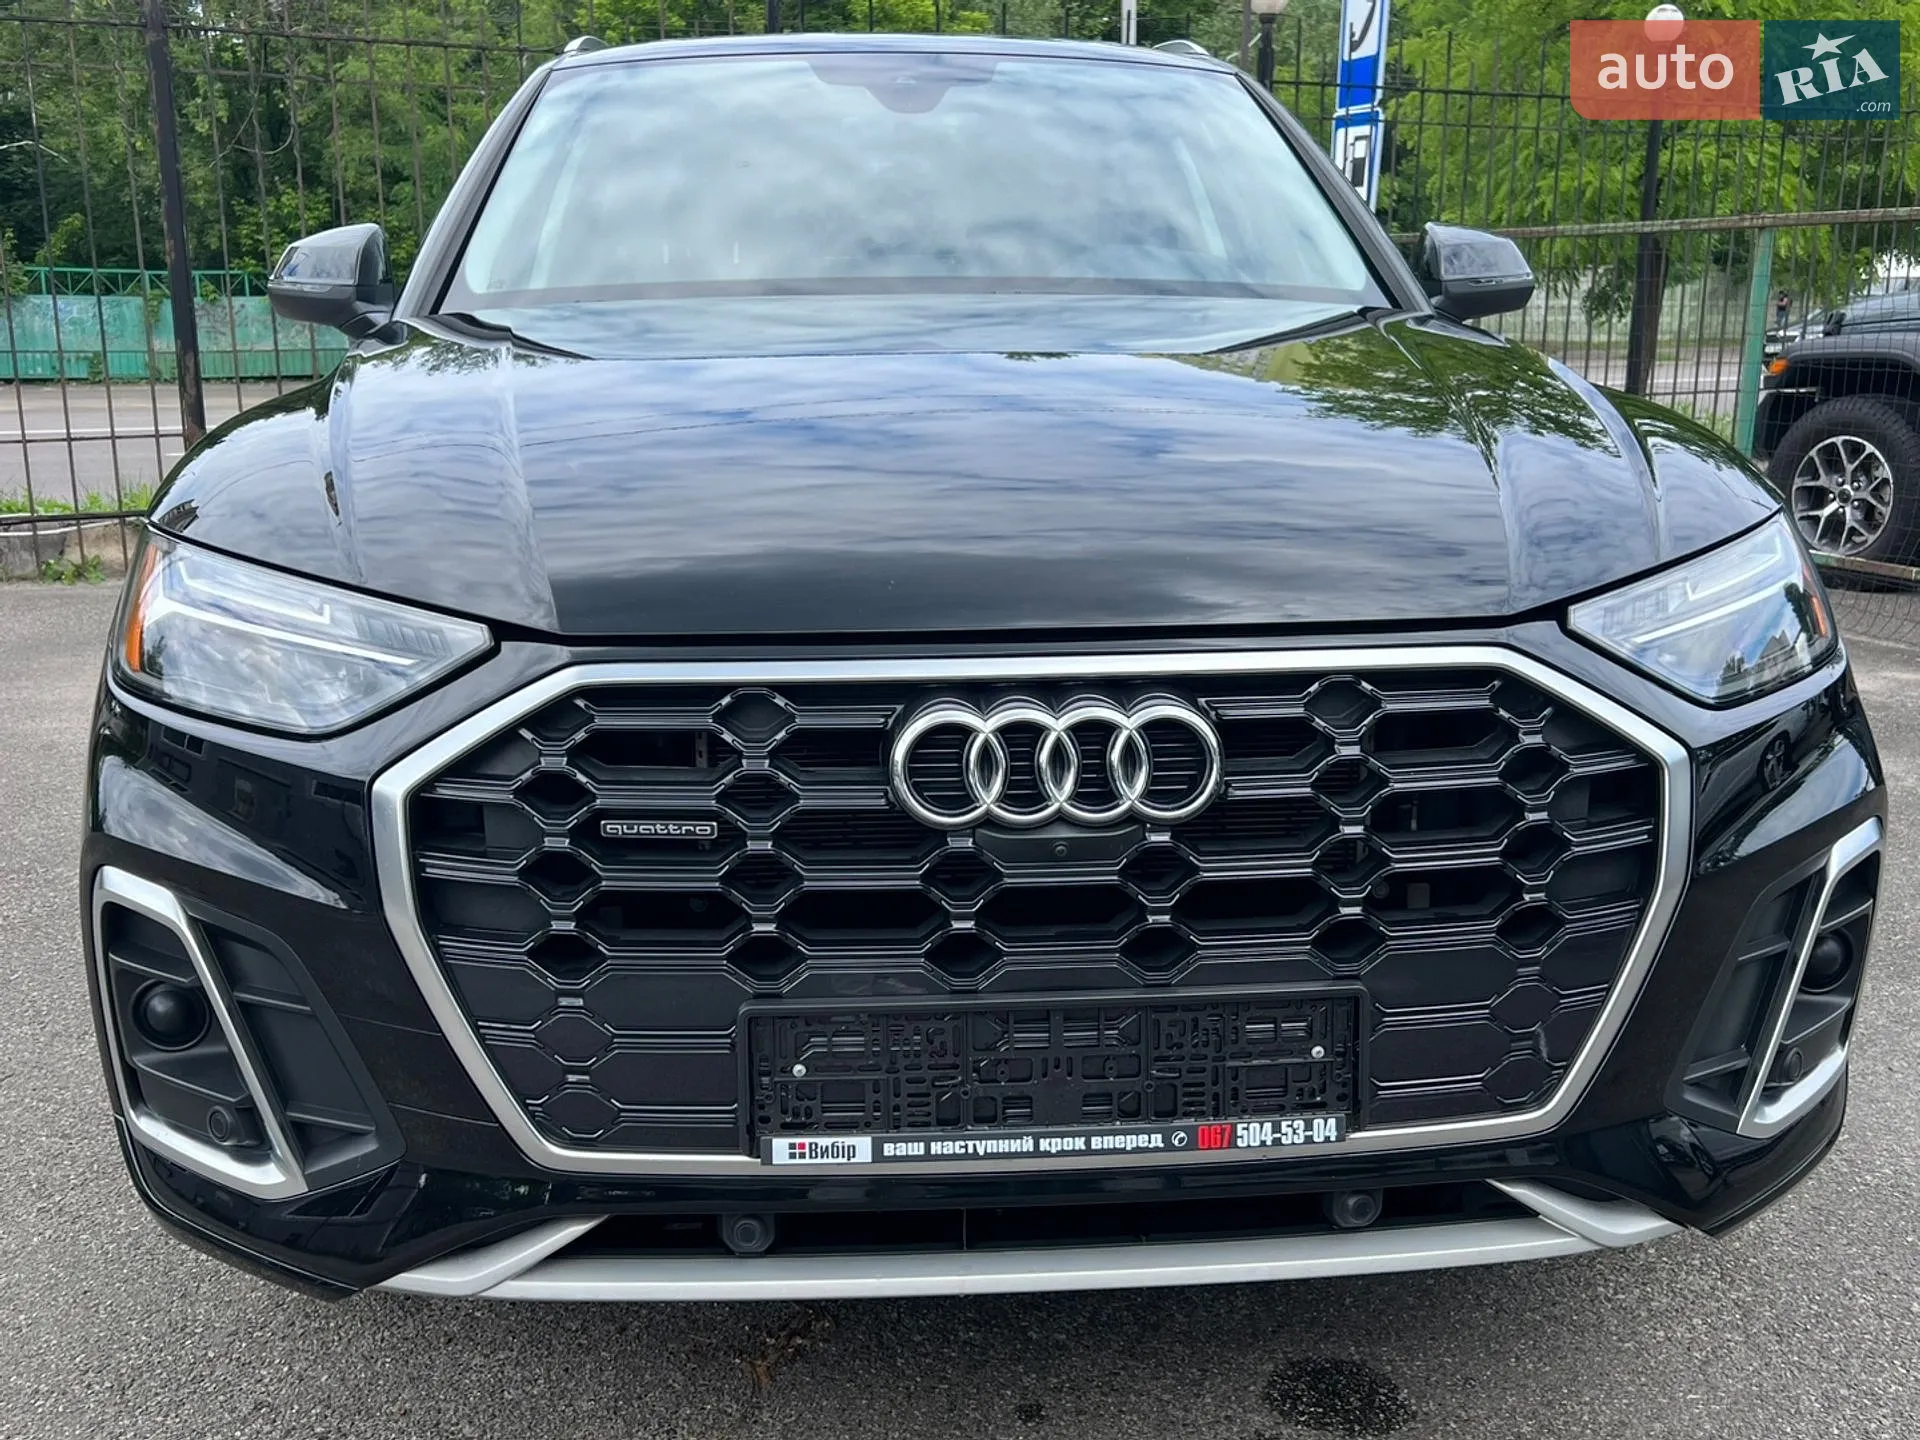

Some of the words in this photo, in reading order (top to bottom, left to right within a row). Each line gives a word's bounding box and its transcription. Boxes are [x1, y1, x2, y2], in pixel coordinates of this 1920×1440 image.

[606, 824, 711, 835] quattro
[883, 1142, 925, 1155] ваш
[931, 1136, 1033, 1155] наступний
[1039, 1135, 1087, 1153] крок
[1091, 1133, 1164, 1150] вперед
[1197, 1124, 1232, 1149] 067
[1237, 1118, 1337, 1148] 504-53-04
[808, 1141, 857, 1161] Вибір
